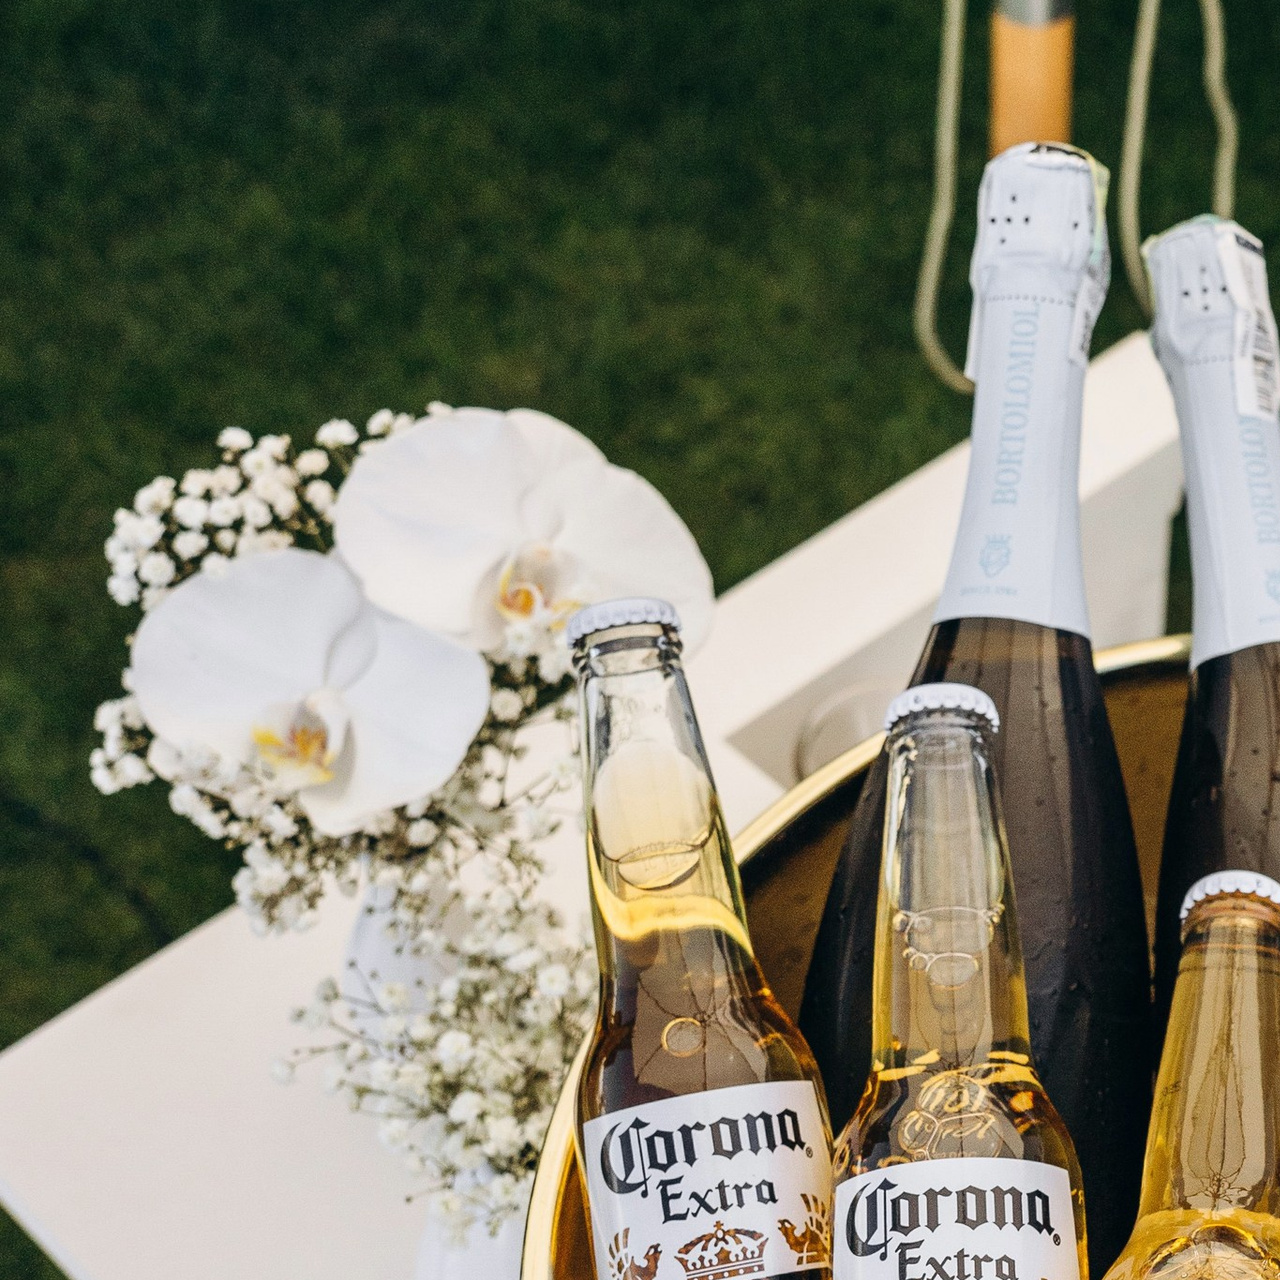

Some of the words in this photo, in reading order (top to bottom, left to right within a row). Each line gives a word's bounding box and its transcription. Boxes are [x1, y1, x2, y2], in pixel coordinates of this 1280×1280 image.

[601, 1108, 807, 1198] Corona
[657, 1174, 778, 1223] Extra
[846, 1177, 1055, 1261] Corona
